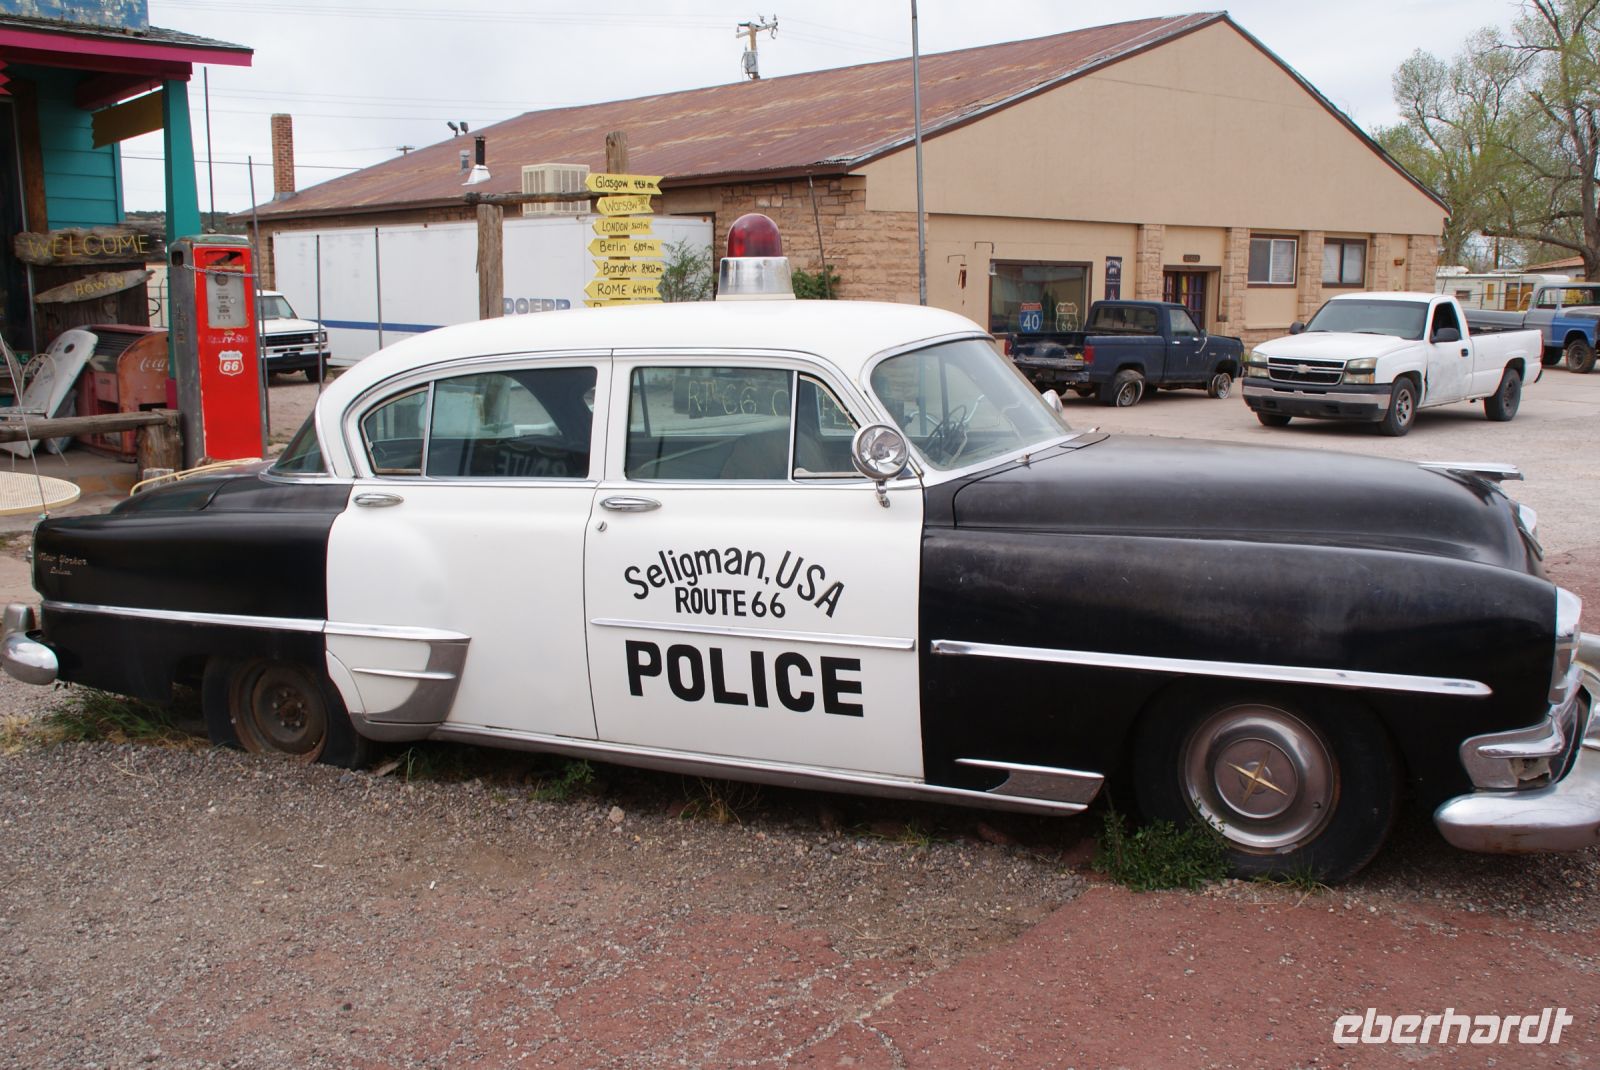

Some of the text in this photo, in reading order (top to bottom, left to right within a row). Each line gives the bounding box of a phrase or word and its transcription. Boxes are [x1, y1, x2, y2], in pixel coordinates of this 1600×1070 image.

[595, 175, 629, 191] Glasgow
[602, 221, 629, 232] LONDON
[28, 234, 151, 257] WELCOME
[599, 240, 627, 253] Berlin
[603, 261, 637, 276] Bangkok
[597, 283, 628, 297] ROME
[1023, 314, 1039, 331] 40
[1061, 320, 1073, 331] 66
[223, 360, 240, 372] 66
[624, 547, 845, 618] Seligman, USA
[674, 586, 786, 619] ROUTE 66
[625, 639, 864, 718] POLICE
